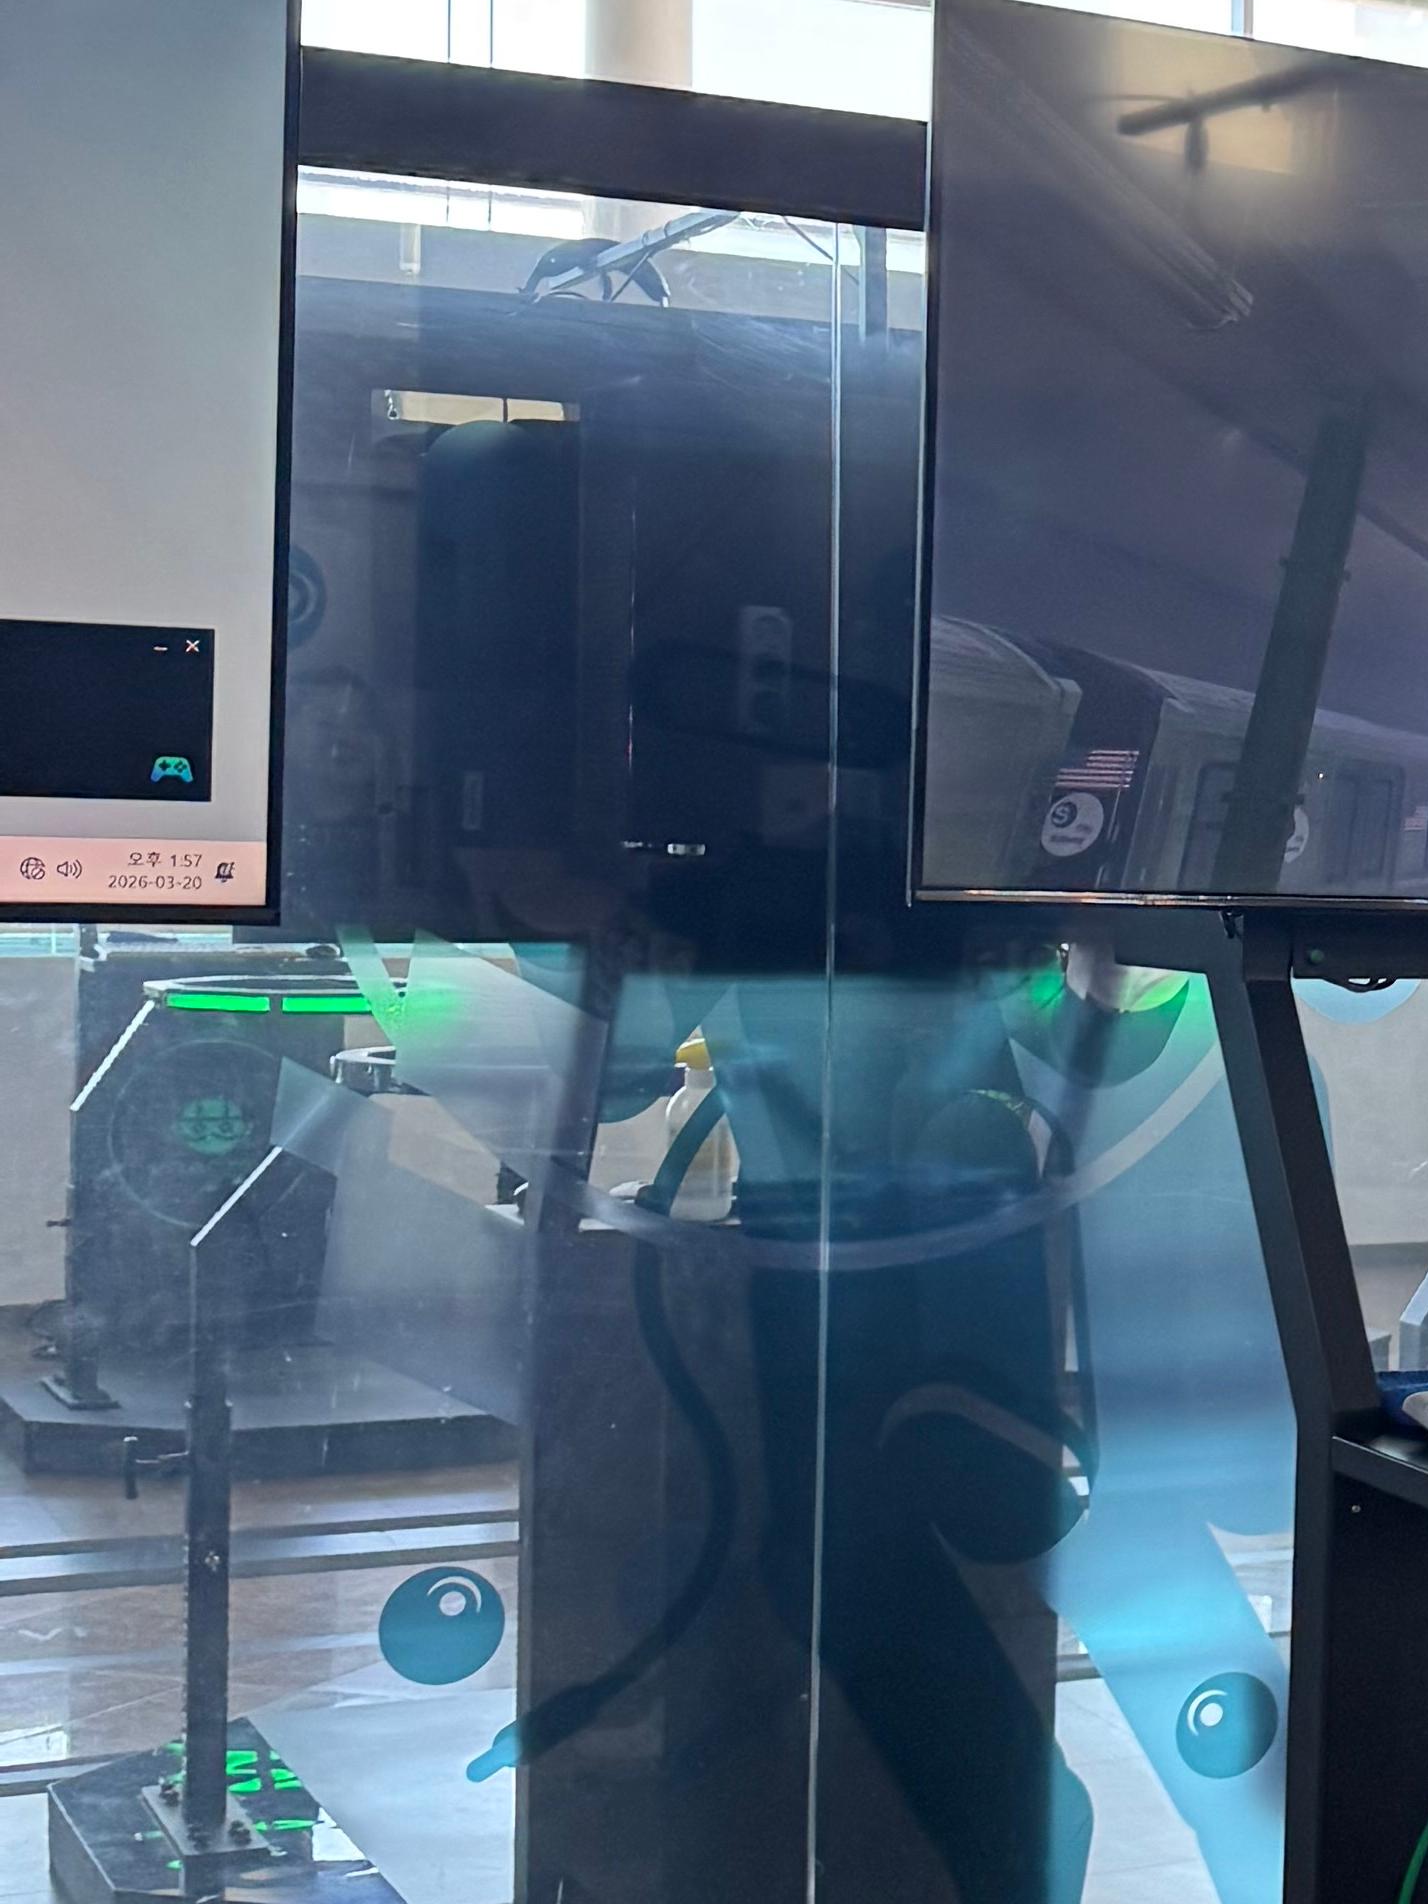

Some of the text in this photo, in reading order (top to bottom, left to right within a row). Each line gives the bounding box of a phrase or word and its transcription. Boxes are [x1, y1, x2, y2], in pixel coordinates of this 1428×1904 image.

[127, 851, 202, 868] 오후 1:57
[108, 874, 203, 890] 2026-03-20
